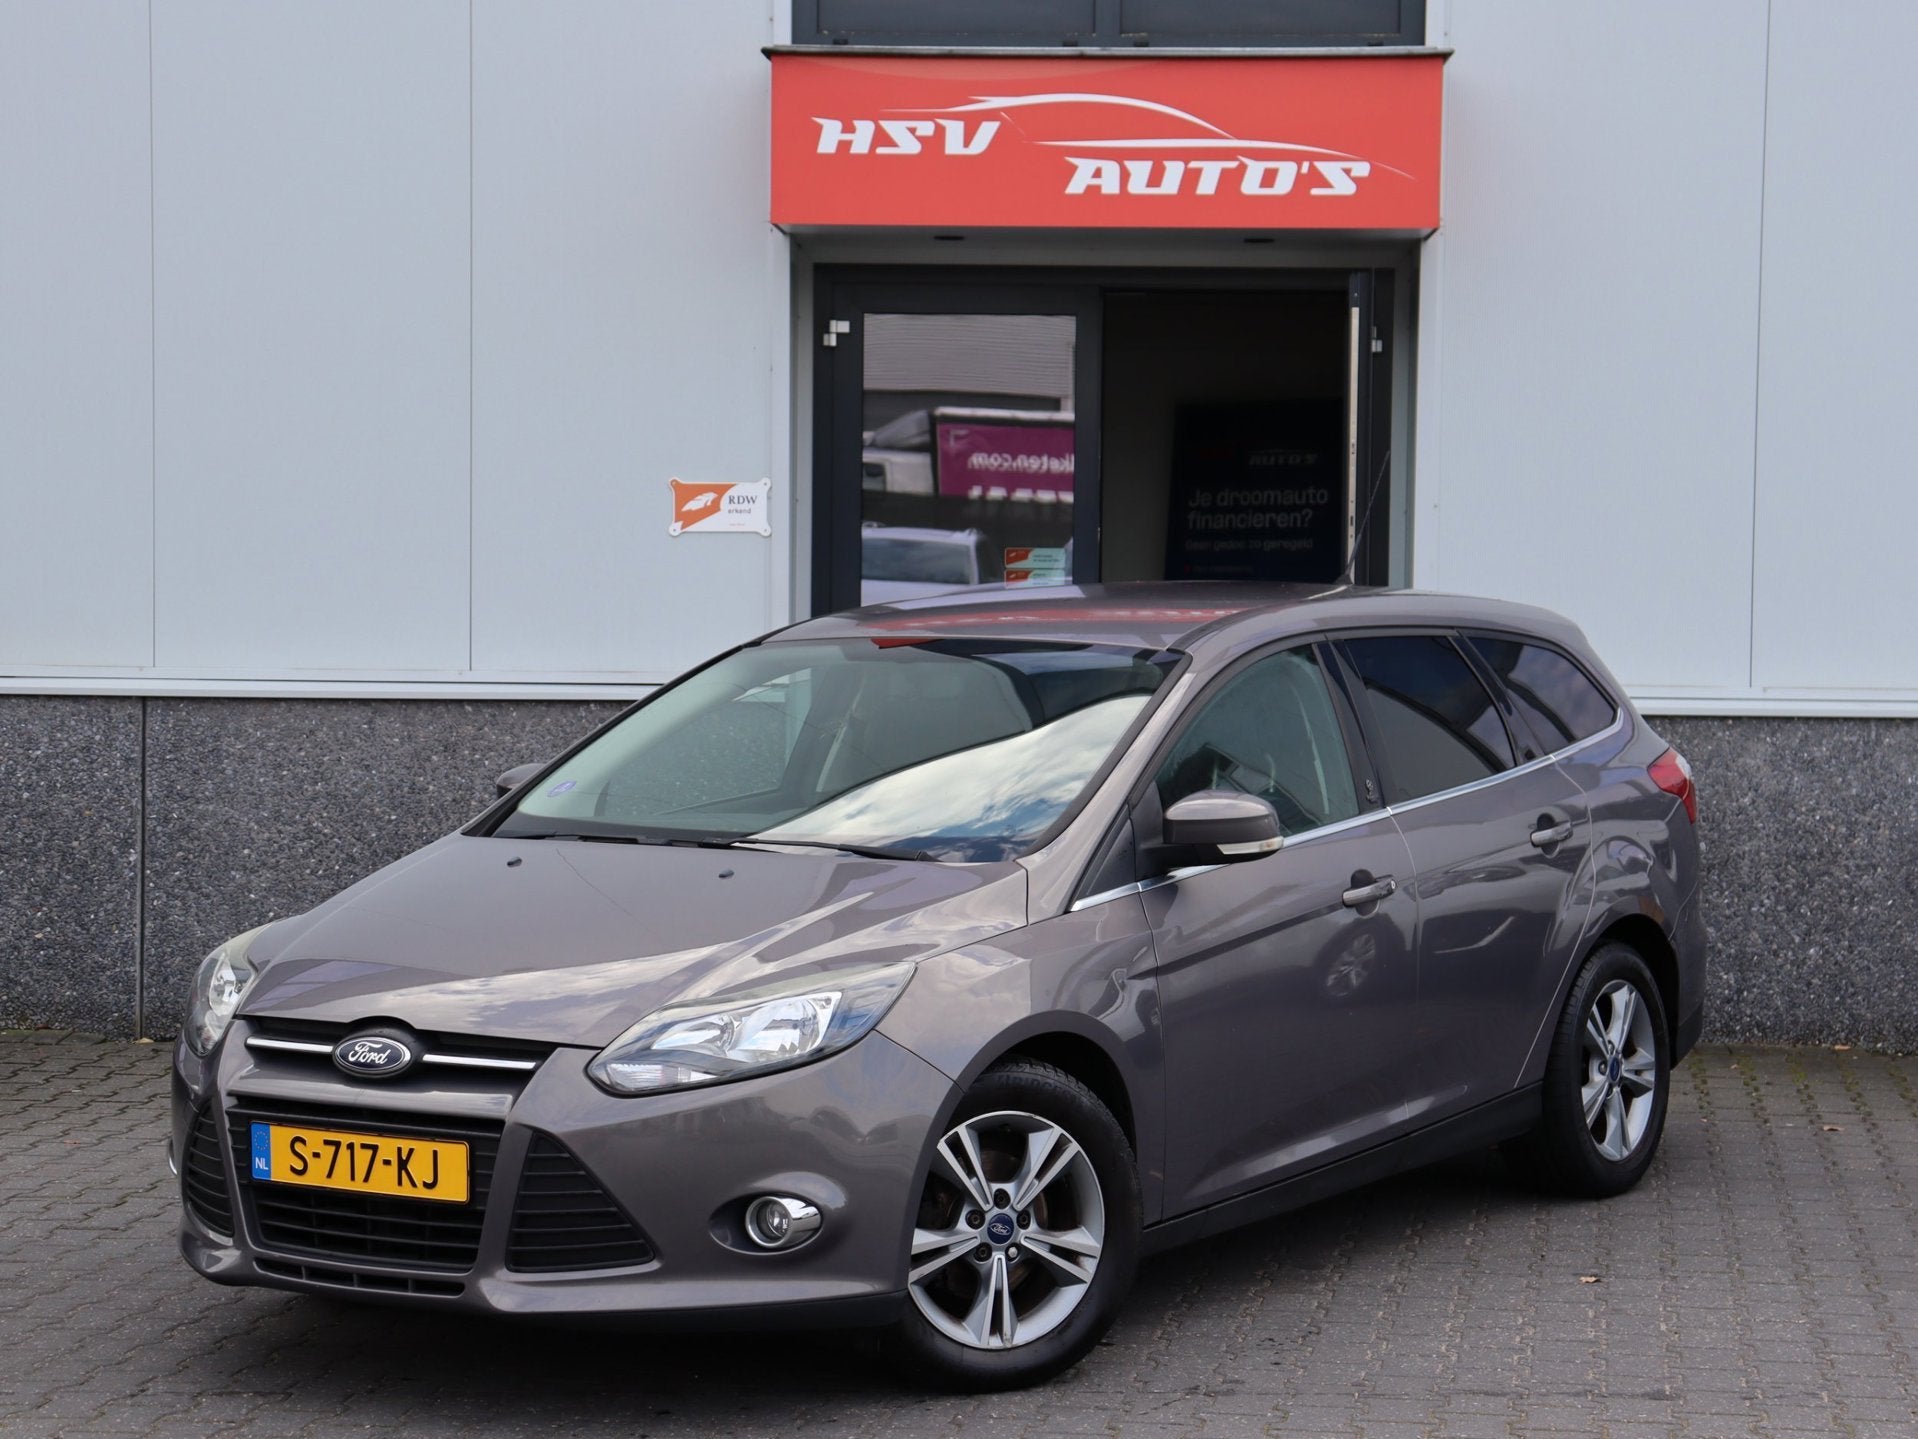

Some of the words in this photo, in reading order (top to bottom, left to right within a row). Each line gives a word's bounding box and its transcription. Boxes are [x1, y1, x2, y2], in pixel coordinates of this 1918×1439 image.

[811, 116, 1001, 155] HSV
[1063, 155, 1371, 196] AUTO'S
[728, 495, 757, 504] RDW
[1188, 489, 1213, 507] Je
[1217, 486, 1328, 506] droomauto
[1187, 509, 1314, 530] financieren?
[348, 1041, 391, 1065] Ford
[255, 1157, 268, 1170] NL
[289, 1135, 439, 1190] S-717-KJ
